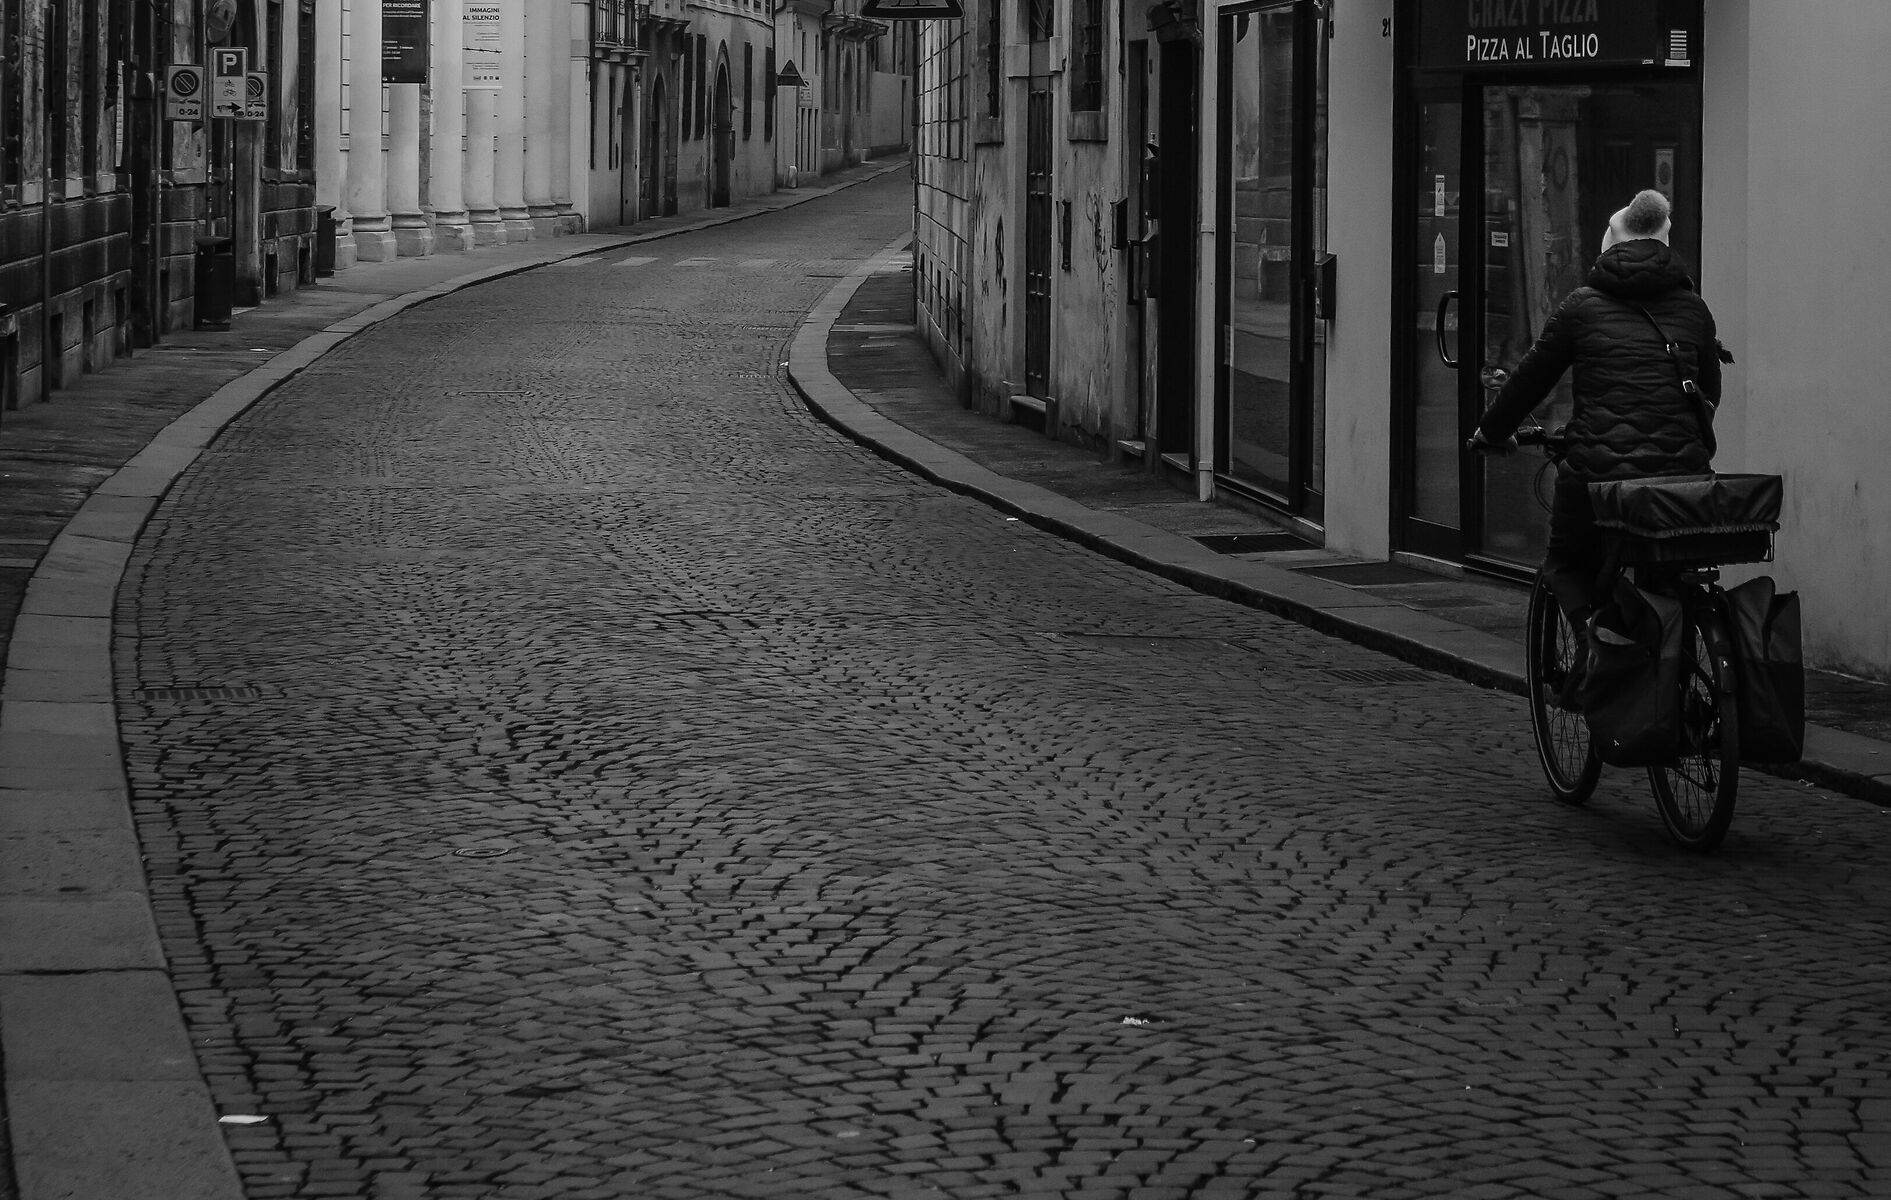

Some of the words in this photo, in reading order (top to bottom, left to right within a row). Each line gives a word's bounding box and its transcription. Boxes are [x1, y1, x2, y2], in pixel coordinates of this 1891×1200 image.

[1466, 34, 1510, 62] PIZZA
[1514, 36, 1534, 60] AL
[1539, 30, 1599, 59] TAGLIO
[223, 53, 237, 73] P
